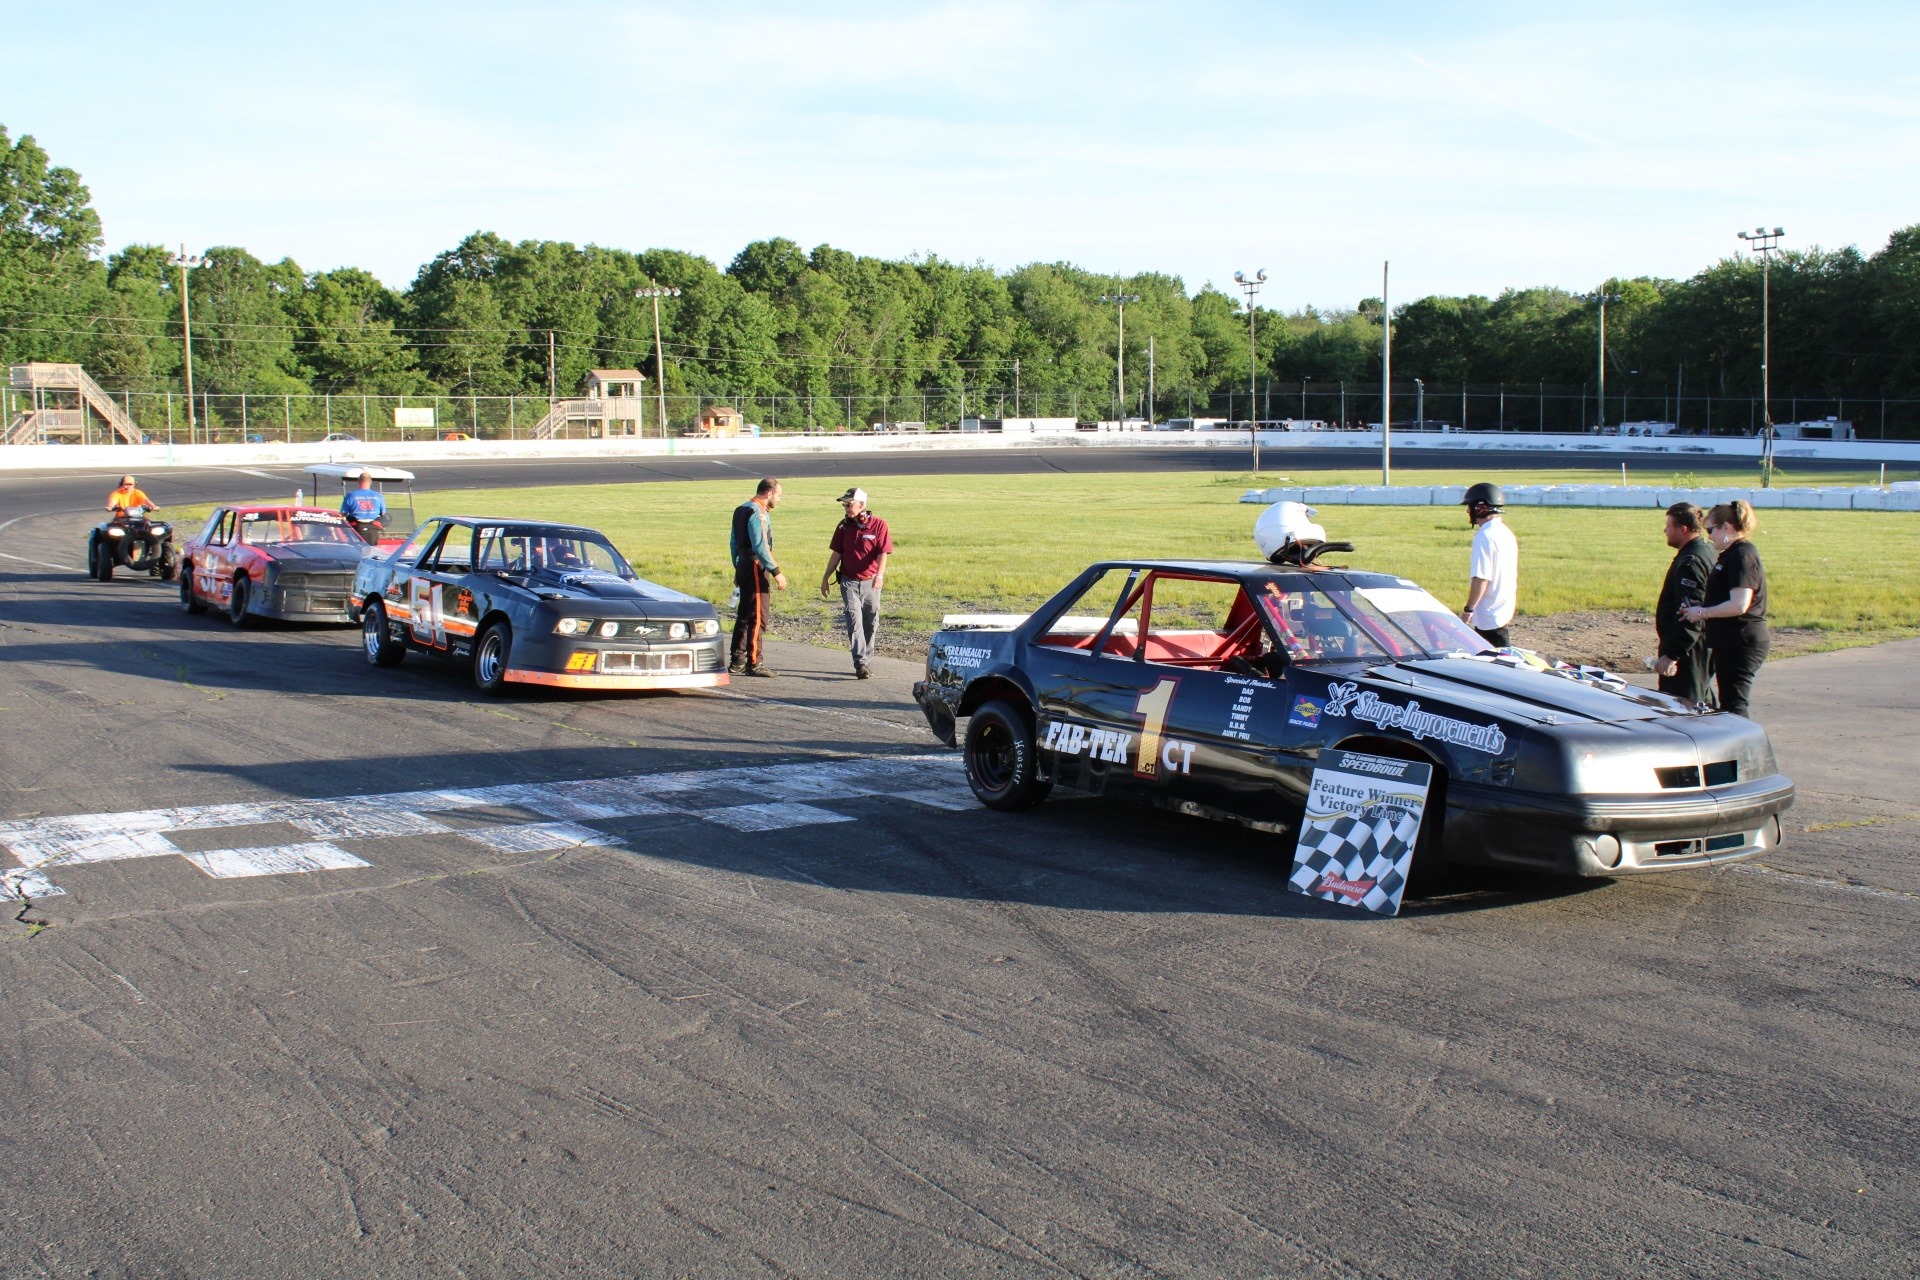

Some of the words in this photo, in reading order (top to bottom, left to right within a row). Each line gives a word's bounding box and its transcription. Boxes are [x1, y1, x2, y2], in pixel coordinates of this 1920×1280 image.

[480, 528, 505, 538] 51
[408, 576, 448, 651] 51
[566, 651, 598, 670] 51
[948, 656, 982, 669] COLLISION
[1225, 676, 1250, 685] Special
[1239, 696, 1251, 704] BOB
[1241, 688, 1254, 696] DAD
[1232, 703, 1253, 713] RANDY
[1295, 705, 1321, 715] SUNOCO
[1132, 675, 1182, 780] 1
[1222, 730, 1237, 738] AUNT
[1238, 732, 1250, 740] PRU
[1043, 721, 1132, 765] FAB-TEK
[1162, 740, 1196, 774] CT
[1338, 758, 1406, 777] SPEEDBOWL
[1312, 778, 1365, 799] Feature
[1368, 788, 1418, 808] Winner
[1320, 794, 1370, 817] Victory
[1370, 804, 1404, 822] Lane
[1321, 875, 1367, 895] Budweiser
